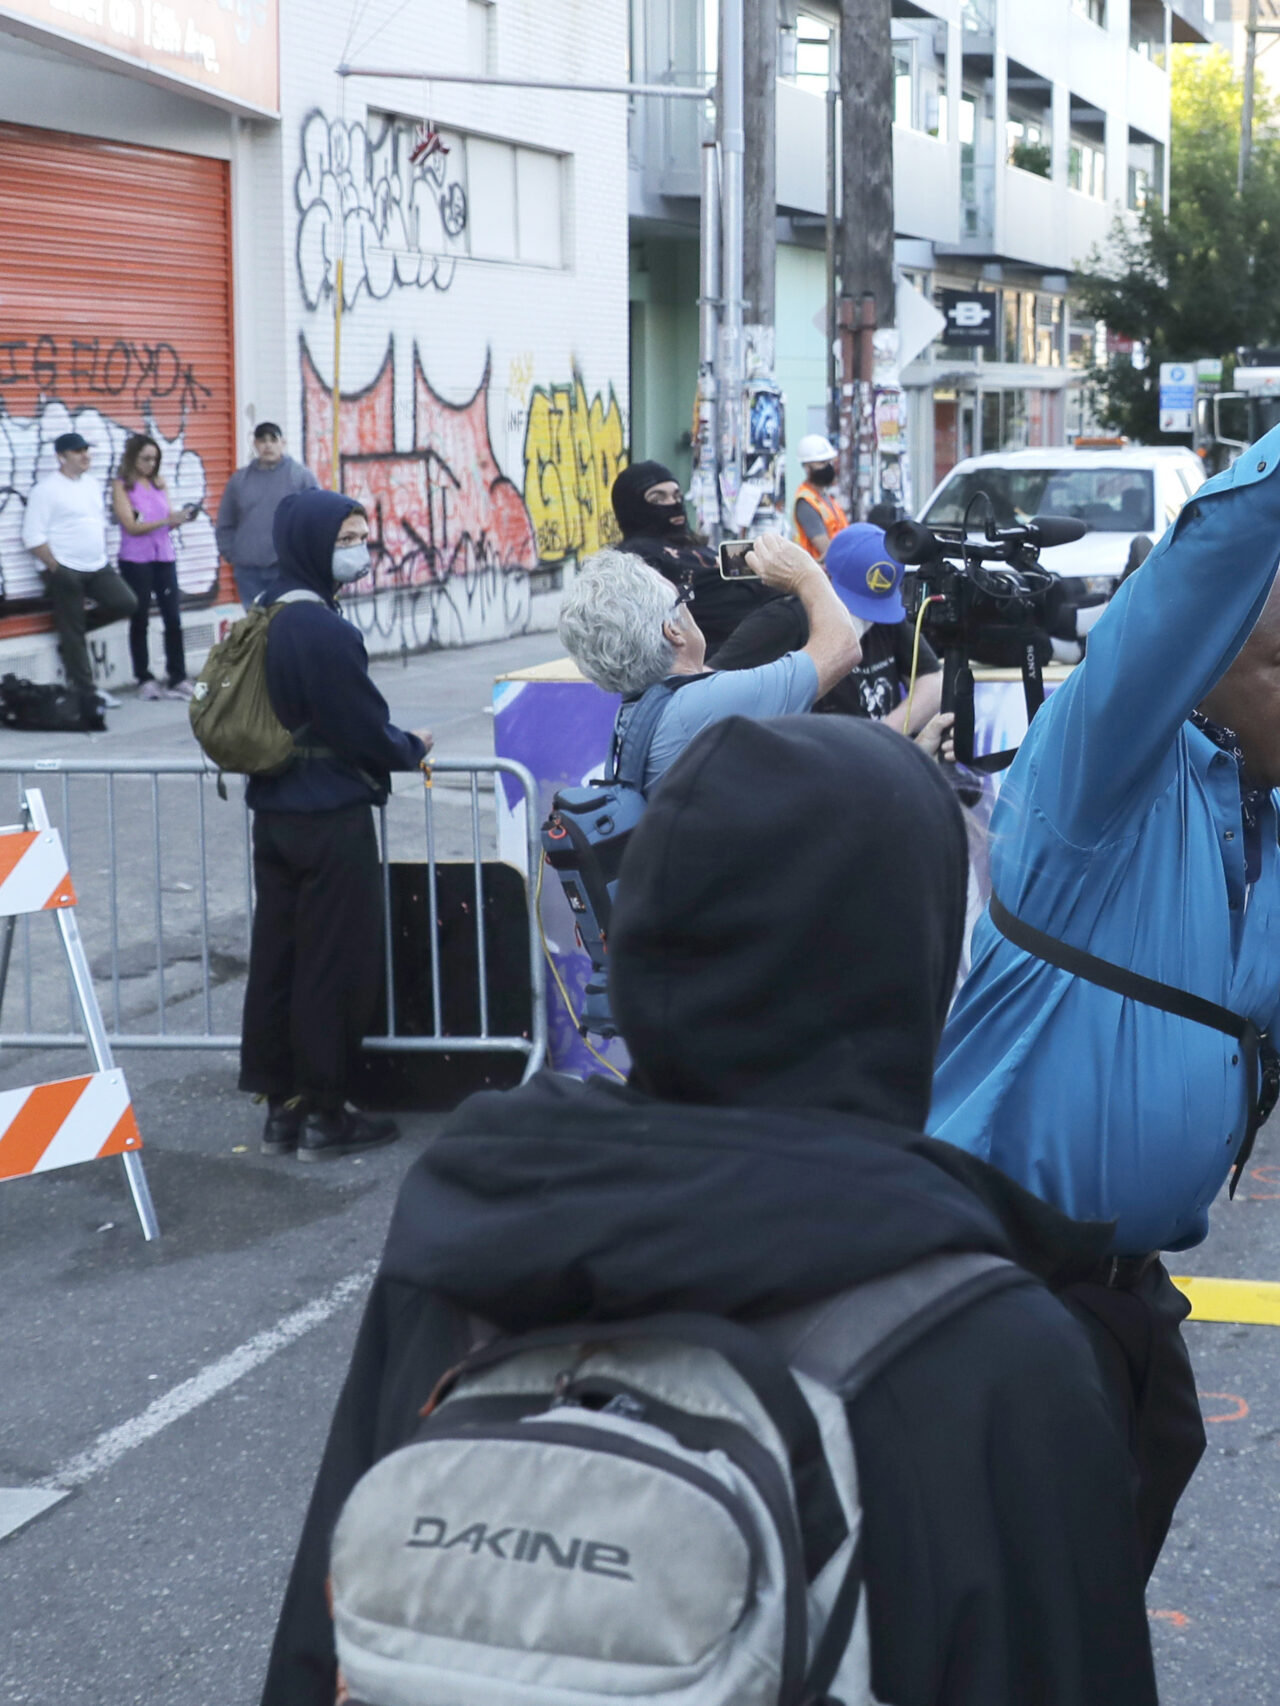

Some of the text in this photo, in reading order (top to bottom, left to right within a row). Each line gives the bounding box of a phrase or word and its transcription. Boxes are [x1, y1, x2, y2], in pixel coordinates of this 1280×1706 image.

[70, 337, 180, 410] FLOYD
[1026, 644, 1037, 679] SONY
[404, 1516, 634, 1582] DAKINE
